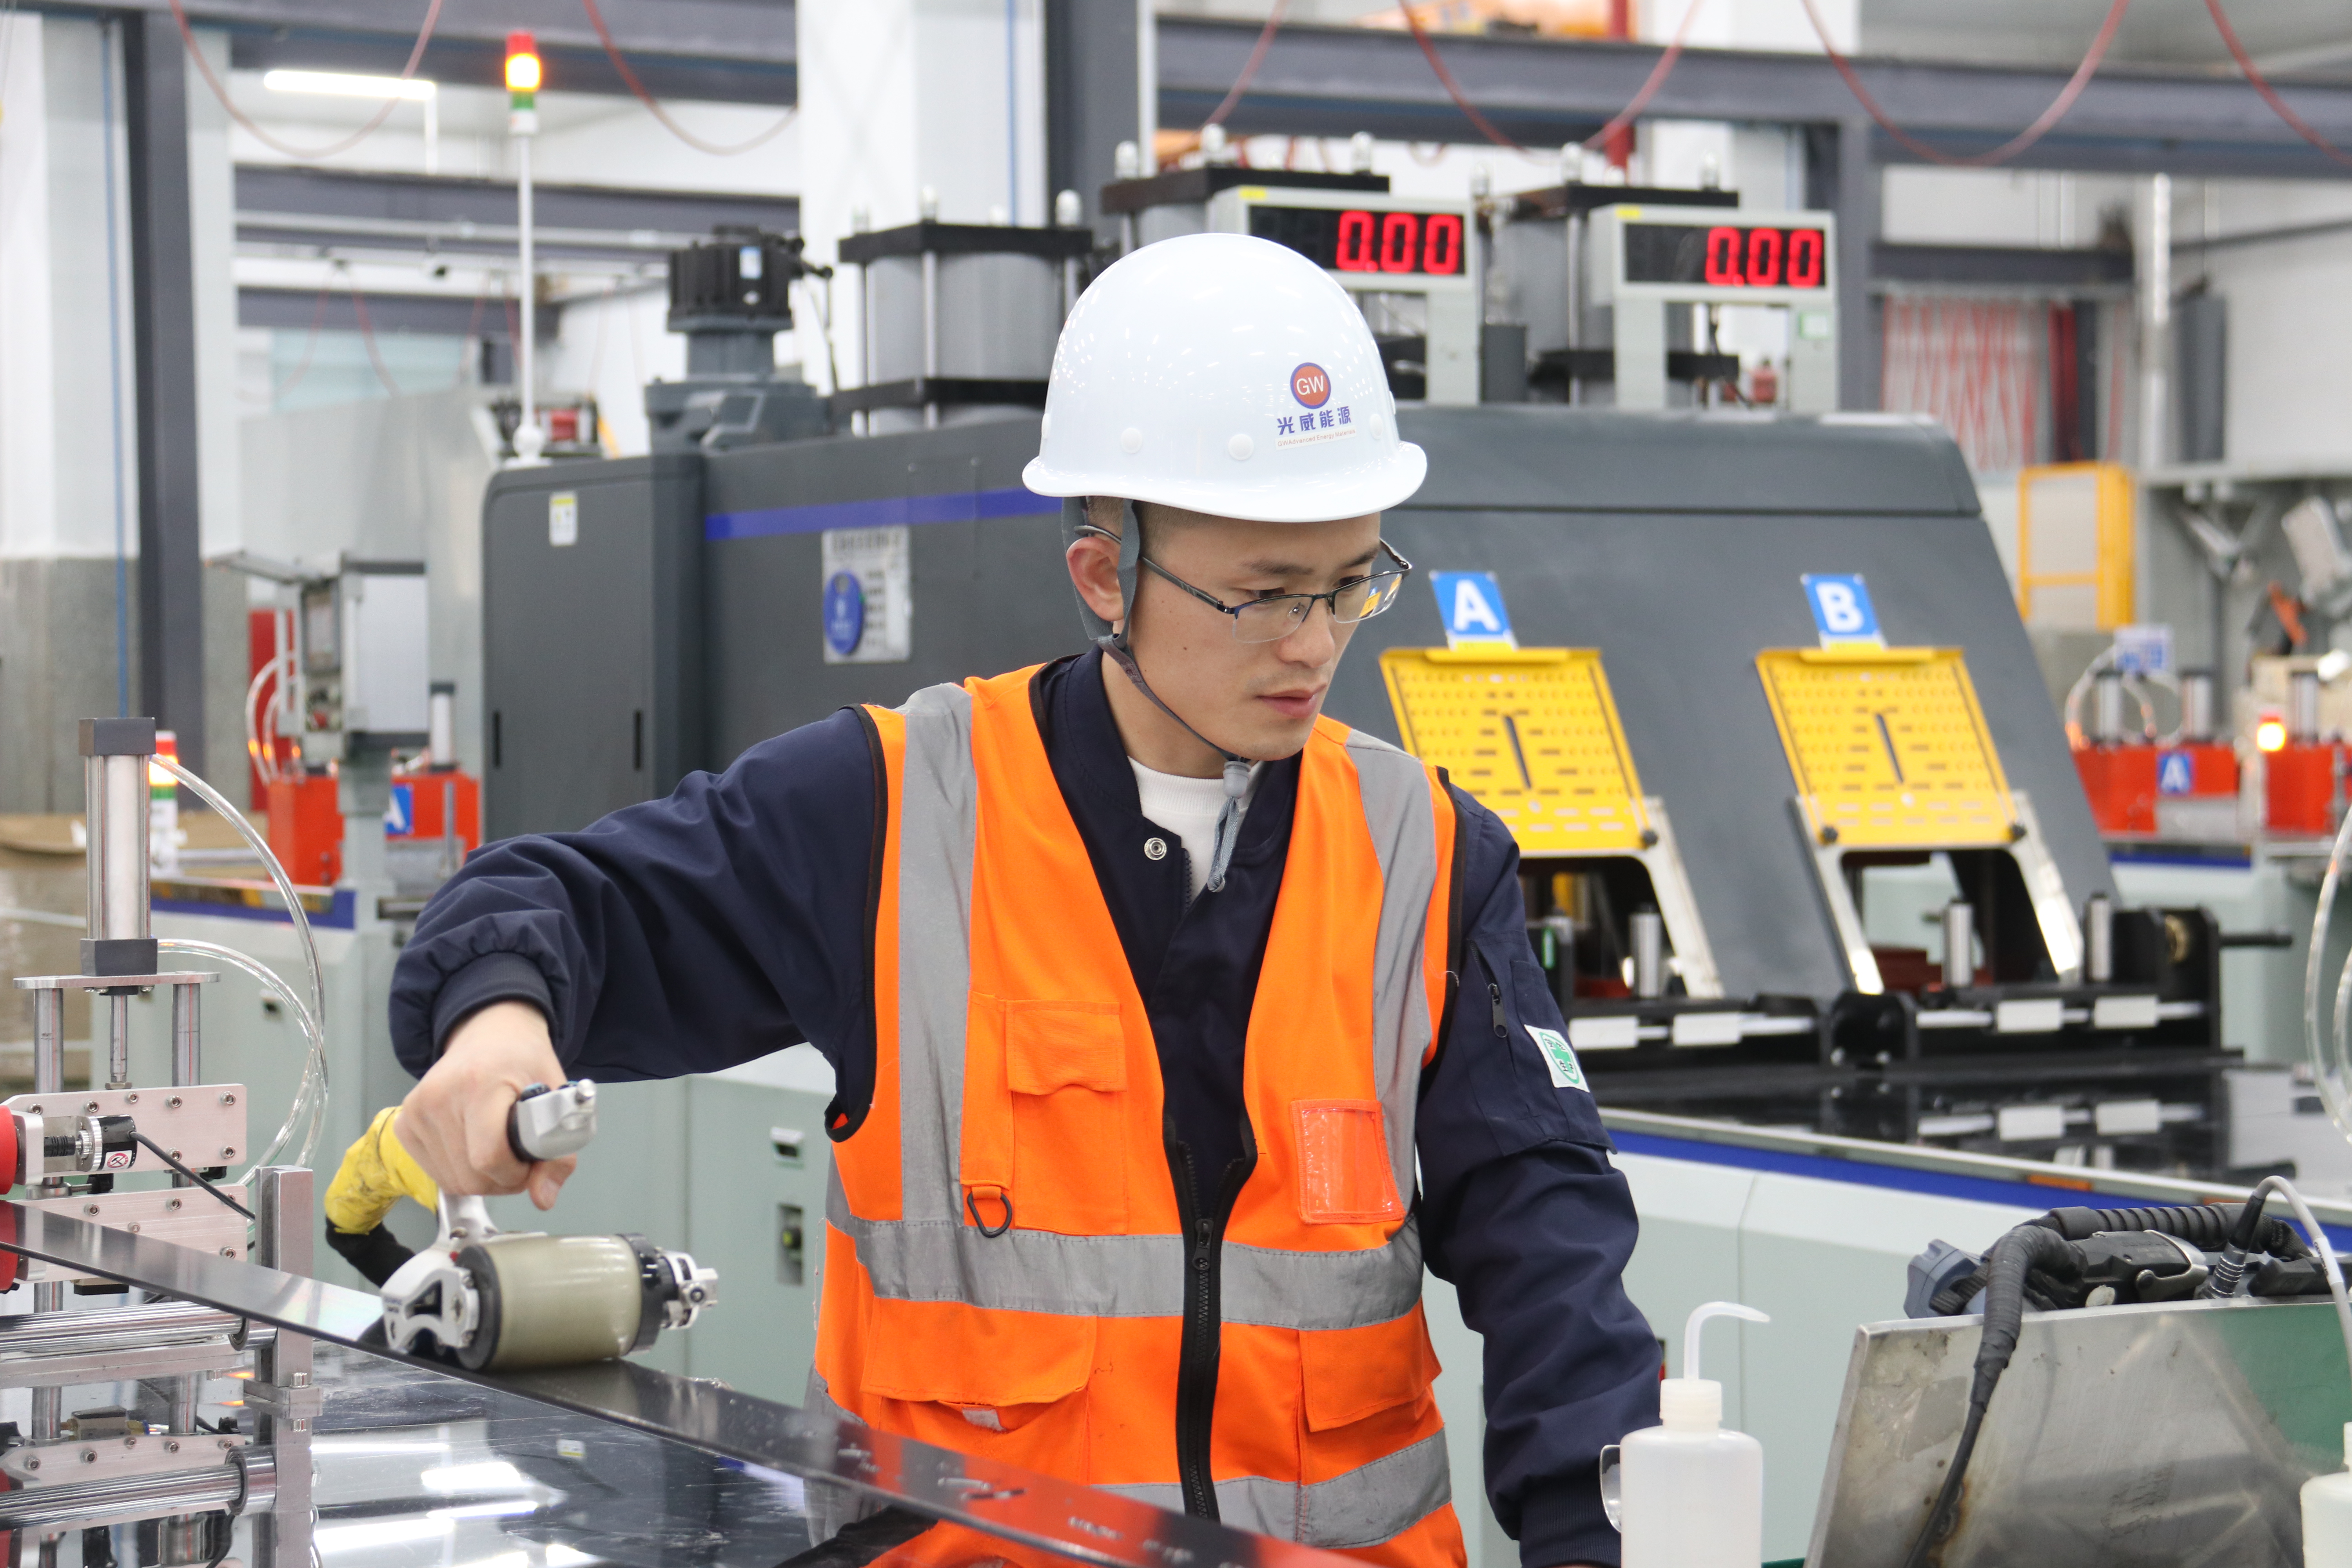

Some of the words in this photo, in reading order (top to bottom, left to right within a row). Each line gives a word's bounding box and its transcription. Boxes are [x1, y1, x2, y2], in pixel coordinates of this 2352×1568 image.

[1336, 210, 1461, 275] 0.00
[1705, 226, 1823, 288] 0.00
[1296, 375, 1324, 395] GW
[1276, 406, 1352, 436] 光威能源
[1453, 579, 1501, 632] A
[1815, 582, 1865, 632] B
[2161, 753, 2189, 791] A
